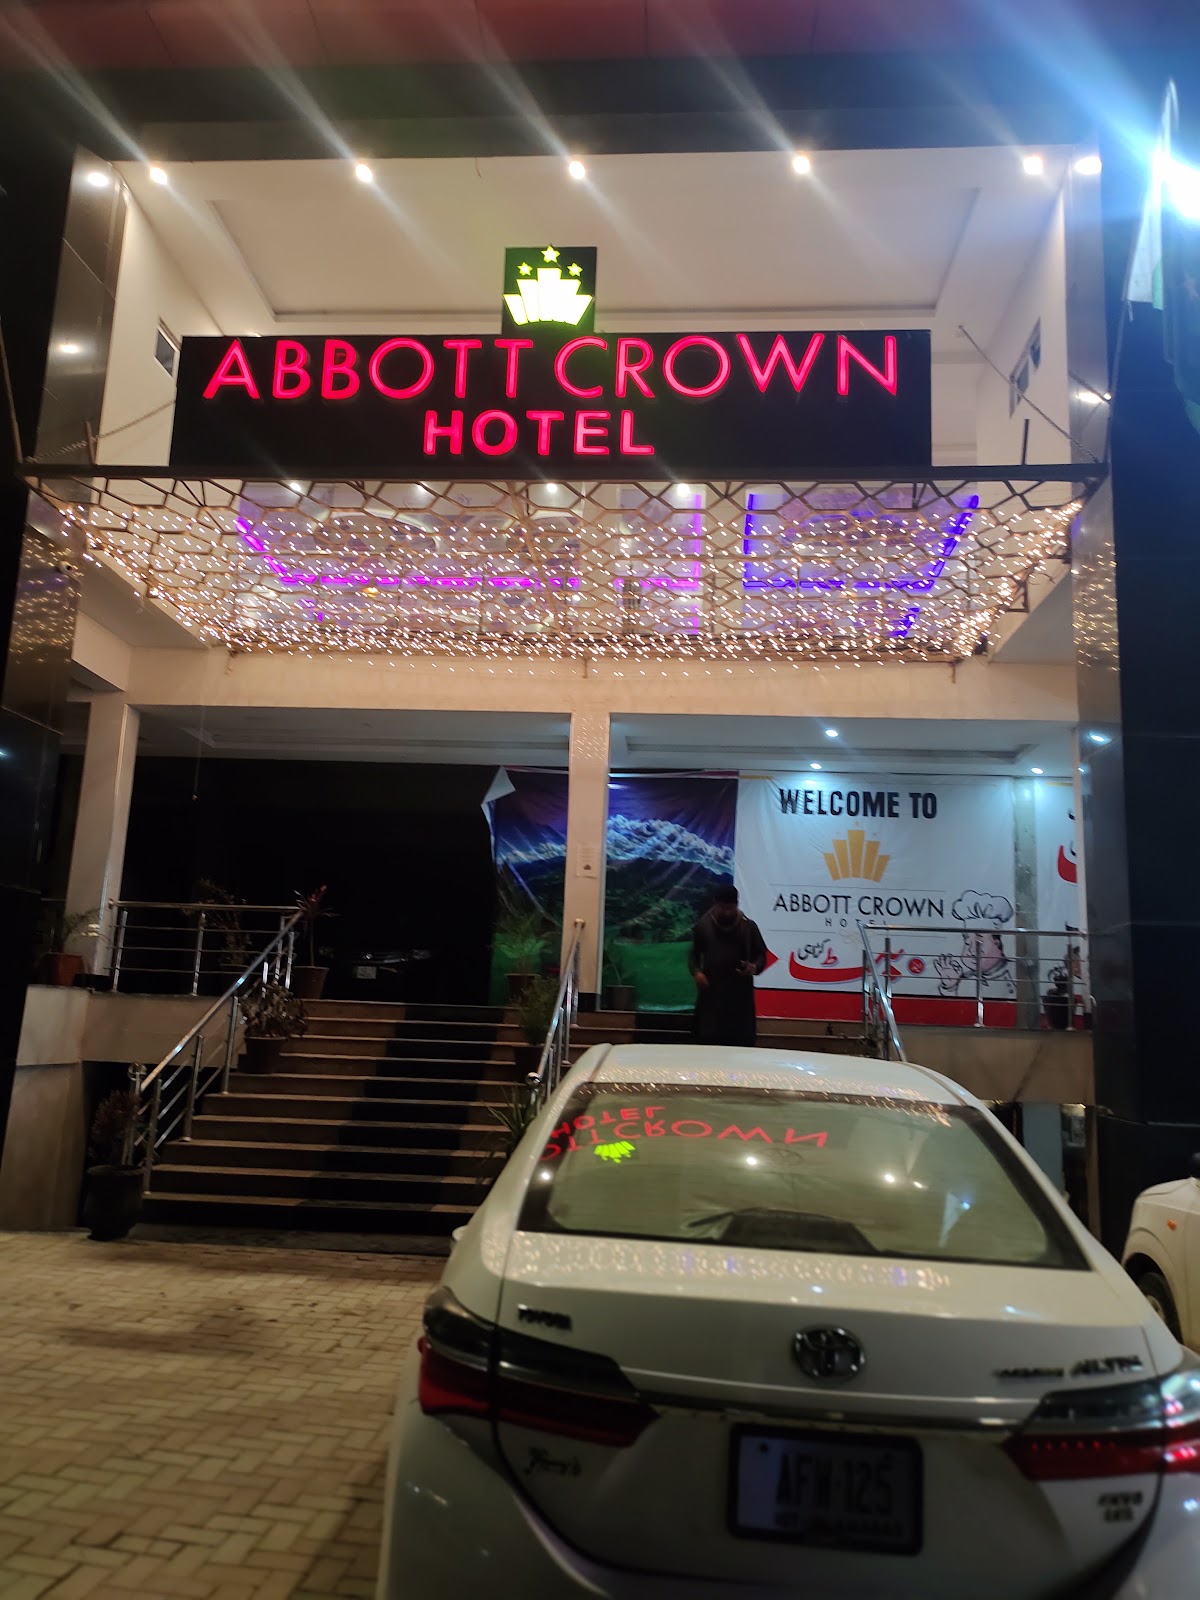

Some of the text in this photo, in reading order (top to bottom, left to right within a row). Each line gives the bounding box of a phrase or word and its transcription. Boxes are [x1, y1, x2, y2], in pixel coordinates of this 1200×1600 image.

[203, 332, 898, 400] ABBOTT CROWN
[424, 409, 655, 456] HOTEL
[779, 788, 937, 819] WELCOME TO
[773, 894, 944, 918] ABBOTT CROWN
